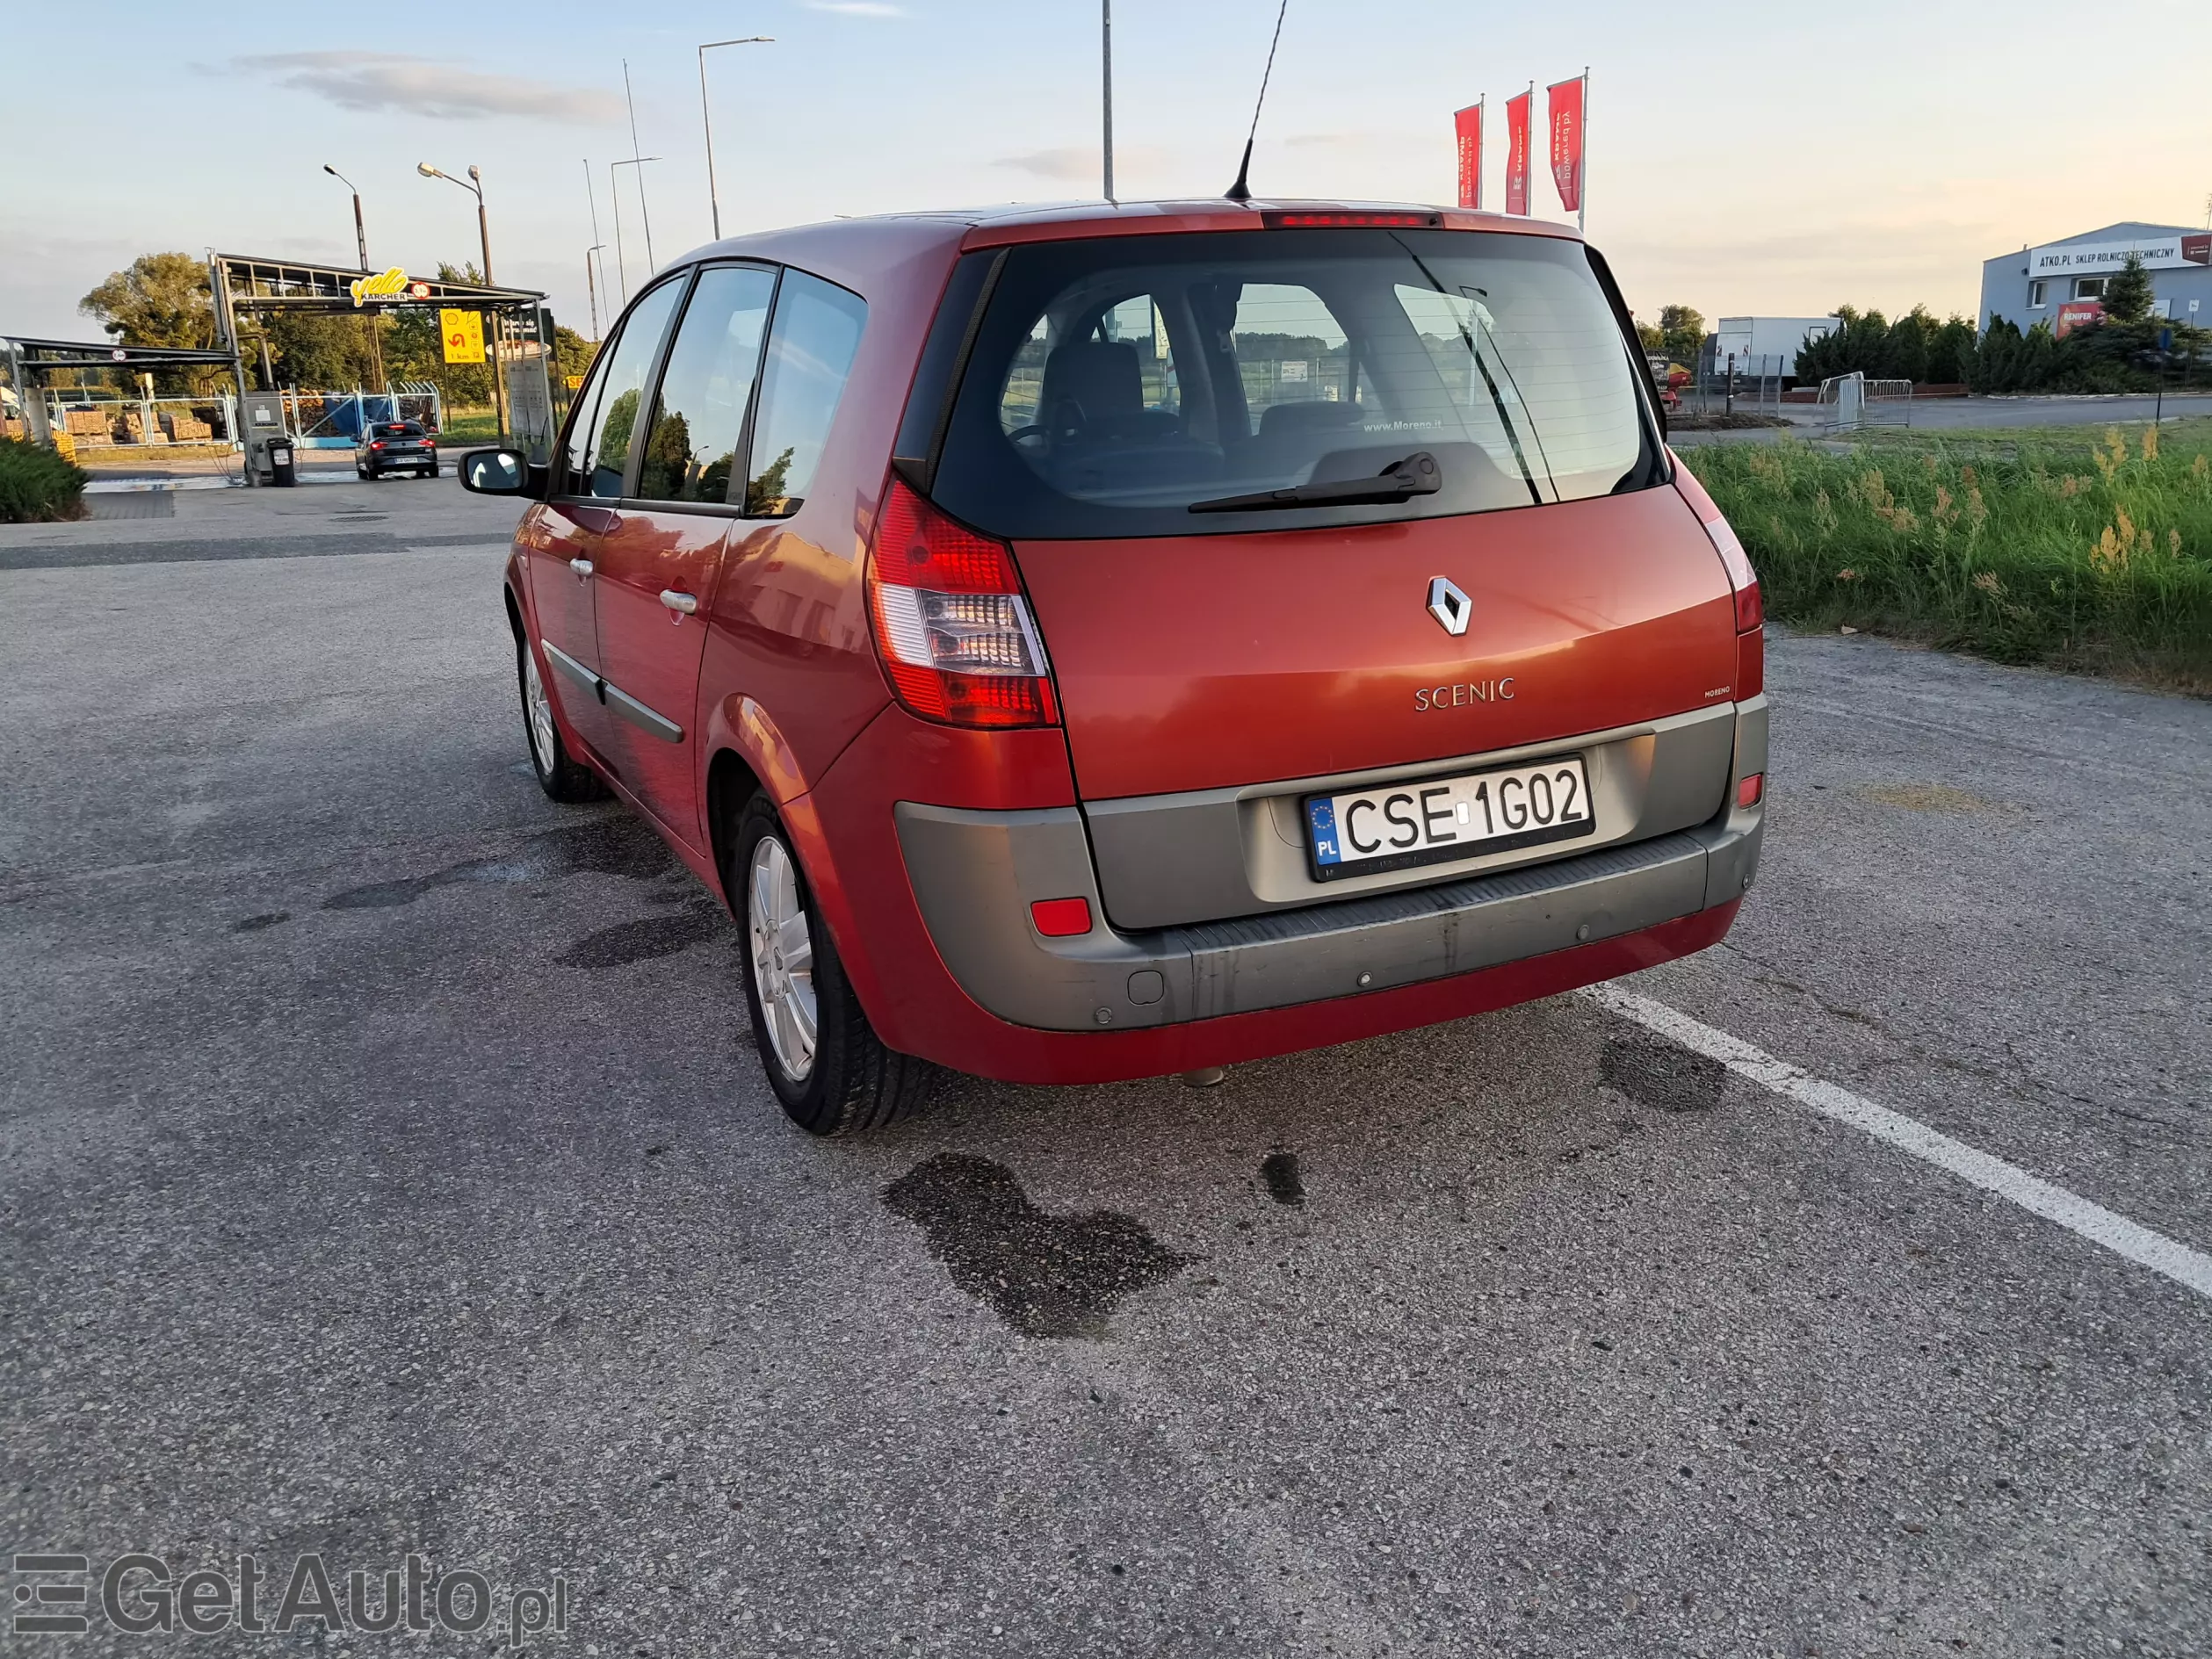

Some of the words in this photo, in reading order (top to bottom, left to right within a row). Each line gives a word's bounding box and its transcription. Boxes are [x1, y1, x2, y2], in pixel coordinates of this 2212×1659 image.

[2040, 254, 2071, 267] ATKO.PL
[2076, 254, 2095, 264] SKLEP
[351, 267, 408, 307] yello
[2064, 312, 2092, 321] RENIFER
[1363, 419, 1442, 432] www.Moreno.it
[1414, 677, 1515, 712] SCENIC
[1704, 686, 1731, 699] MORENO
[1346, 787, 1457, 854] CSE
[1475, 769, 1582, 833] 1G02
[1317, 840, 1337, 856] PL
